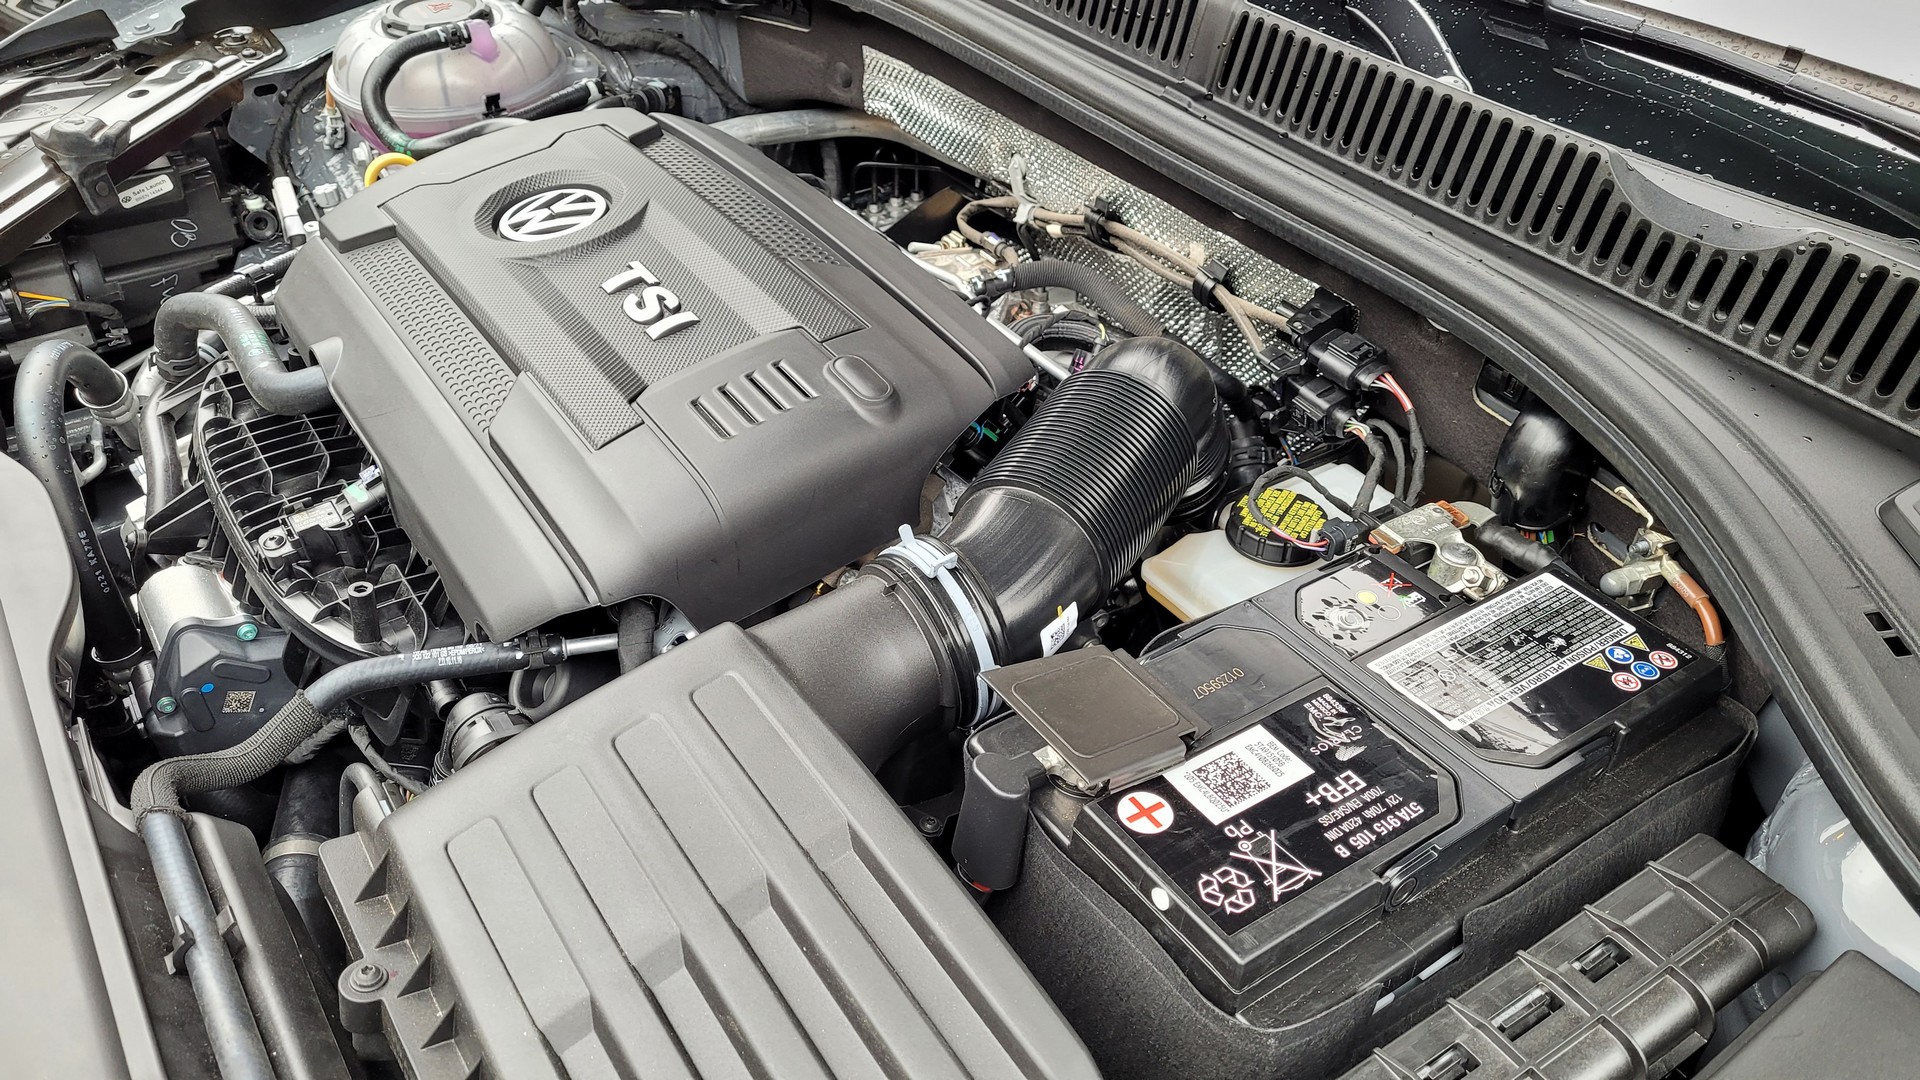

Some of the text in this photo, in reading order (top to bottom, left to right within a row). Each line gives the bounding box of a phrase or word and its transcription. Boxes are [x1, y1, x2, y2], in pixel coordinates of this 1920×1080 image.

[601, 260, 700, 341] TSI
[95, 570, 110, 593] 0221
[1566, 628, 1629, 664] DANGER/POISON
[1192, 667, 1245, 700] 01239507
[1494, 663, 1564, 704] PELIGRO/VENENO
[1266, 741, 1292, 763] BEM Code:
[1310, 725, 1362, 757] CLARIOS
[1306, 770, 1367, 805] EFB+
[1318, 786, 1385, 826] 700A EN/SAE/GS
[1324, 793, 1403, 842] 12V 70Ah 420A DIN
[1224, 819, 1254, 838] Pb
[1334, 802, 1424, 858] 5TA 915 105 B
